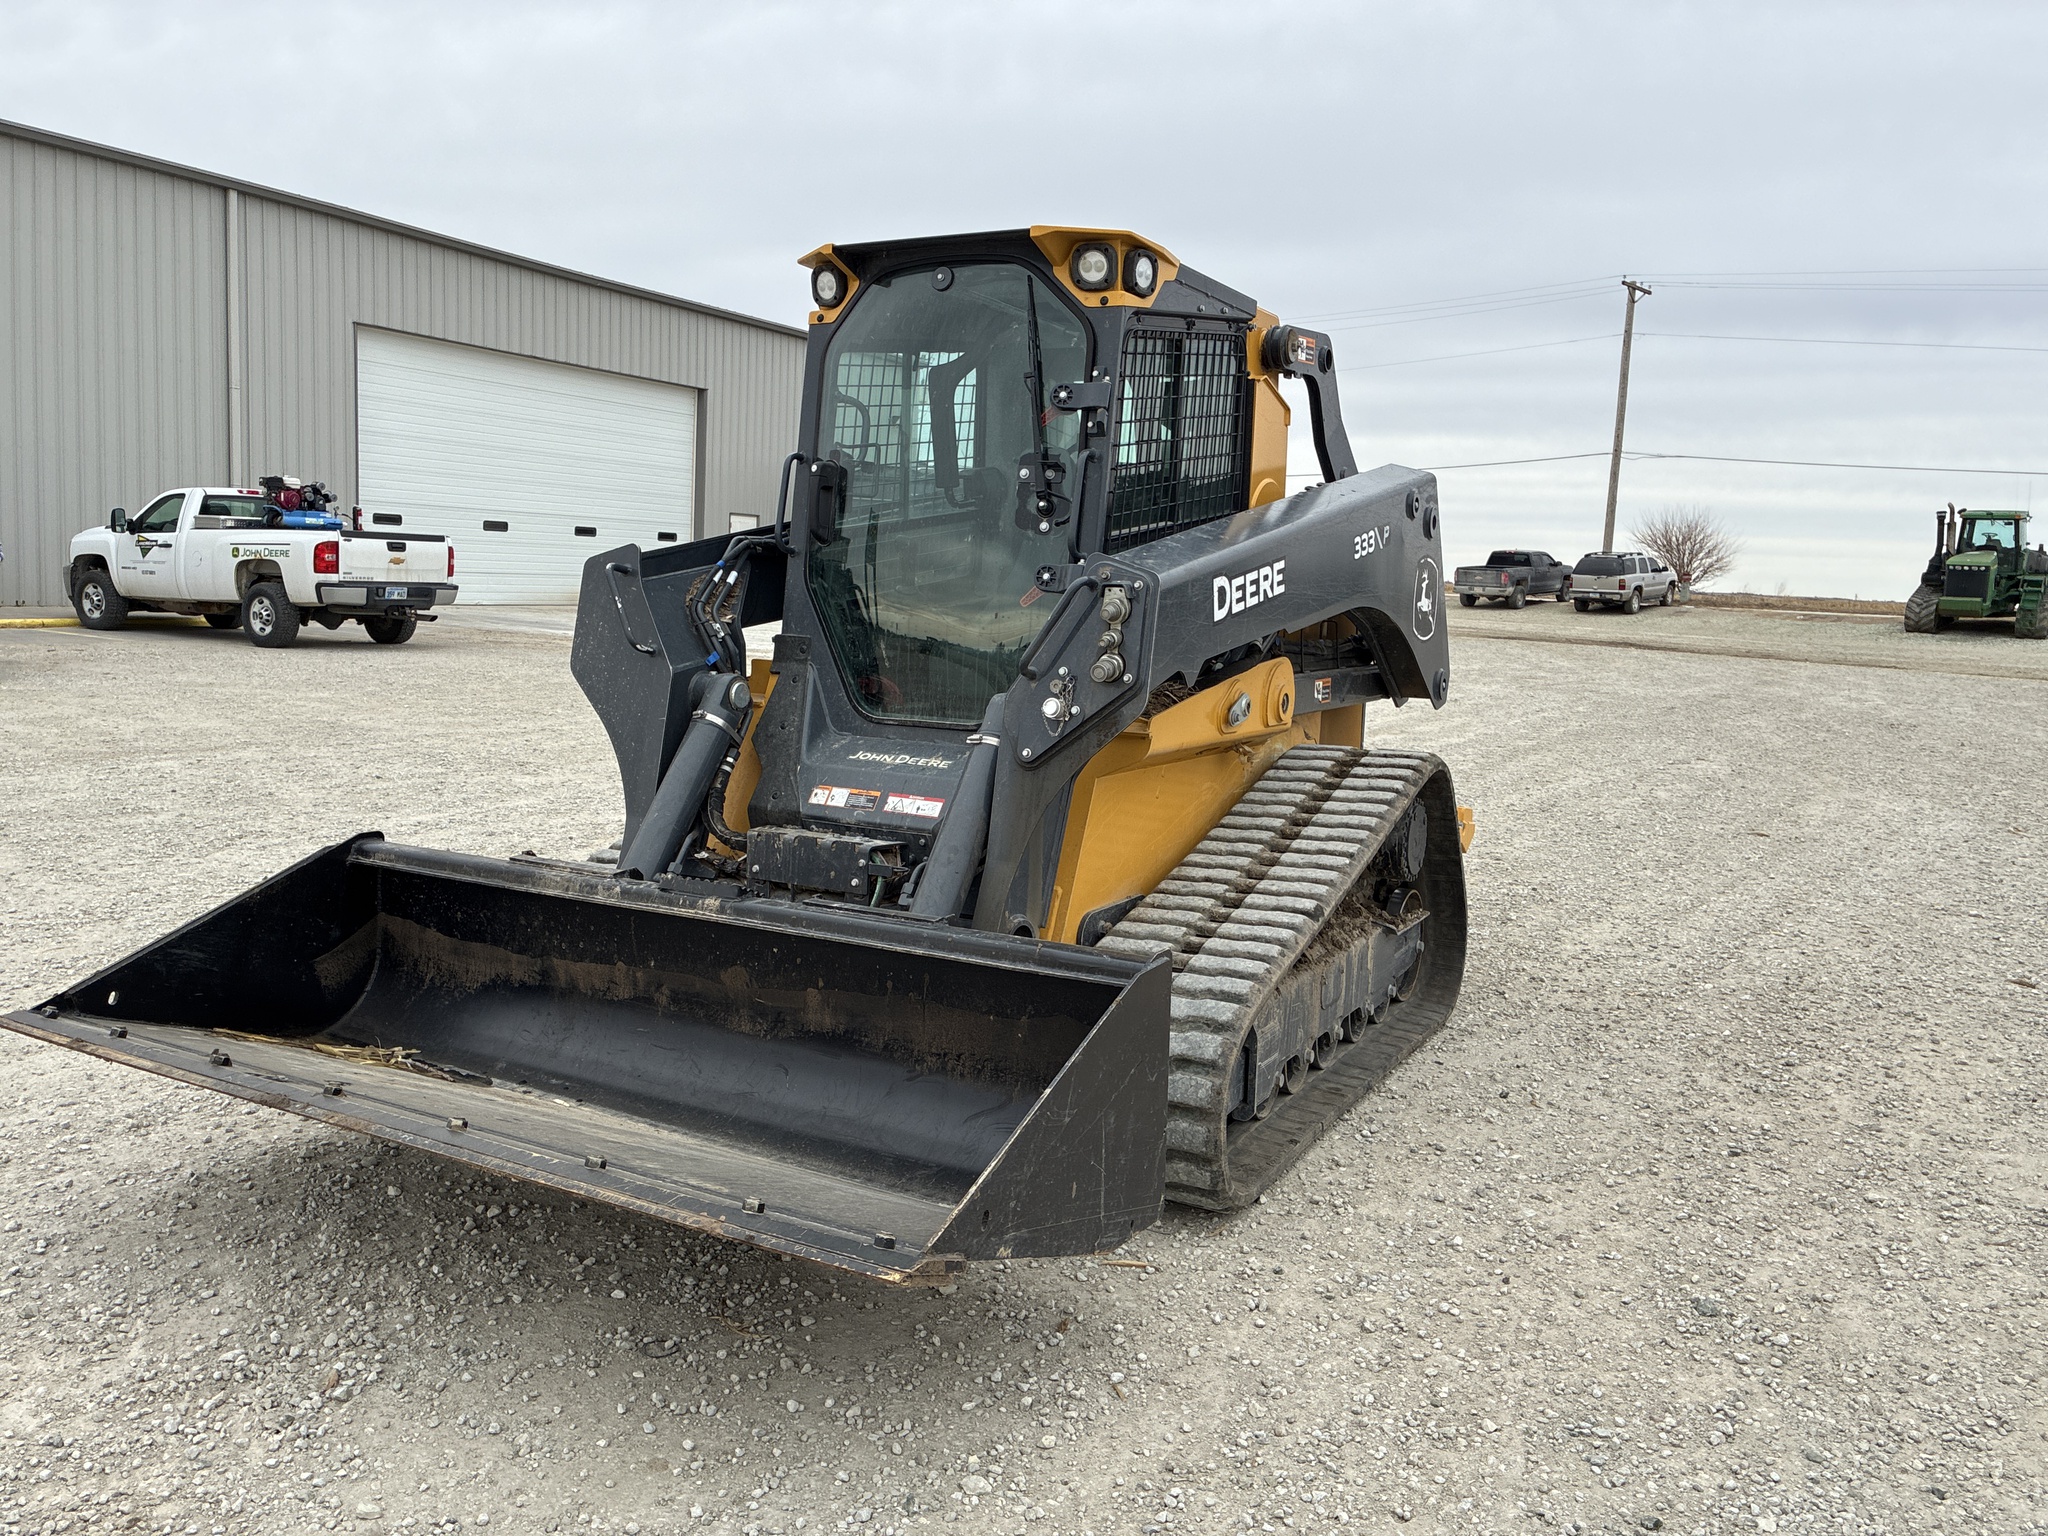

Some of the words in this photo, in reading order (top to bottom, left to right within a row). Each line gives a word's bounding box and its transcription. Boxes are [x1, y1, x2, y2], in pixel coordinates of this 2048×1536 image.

[240, 547, 263, 558] JOHN
[263, 547, 290, 558] DEERE
[1213, 559, 1286, 622] DEERE
[848, 750, 895, 763] JOHN
[894, 755, 953, 769] DEERE
